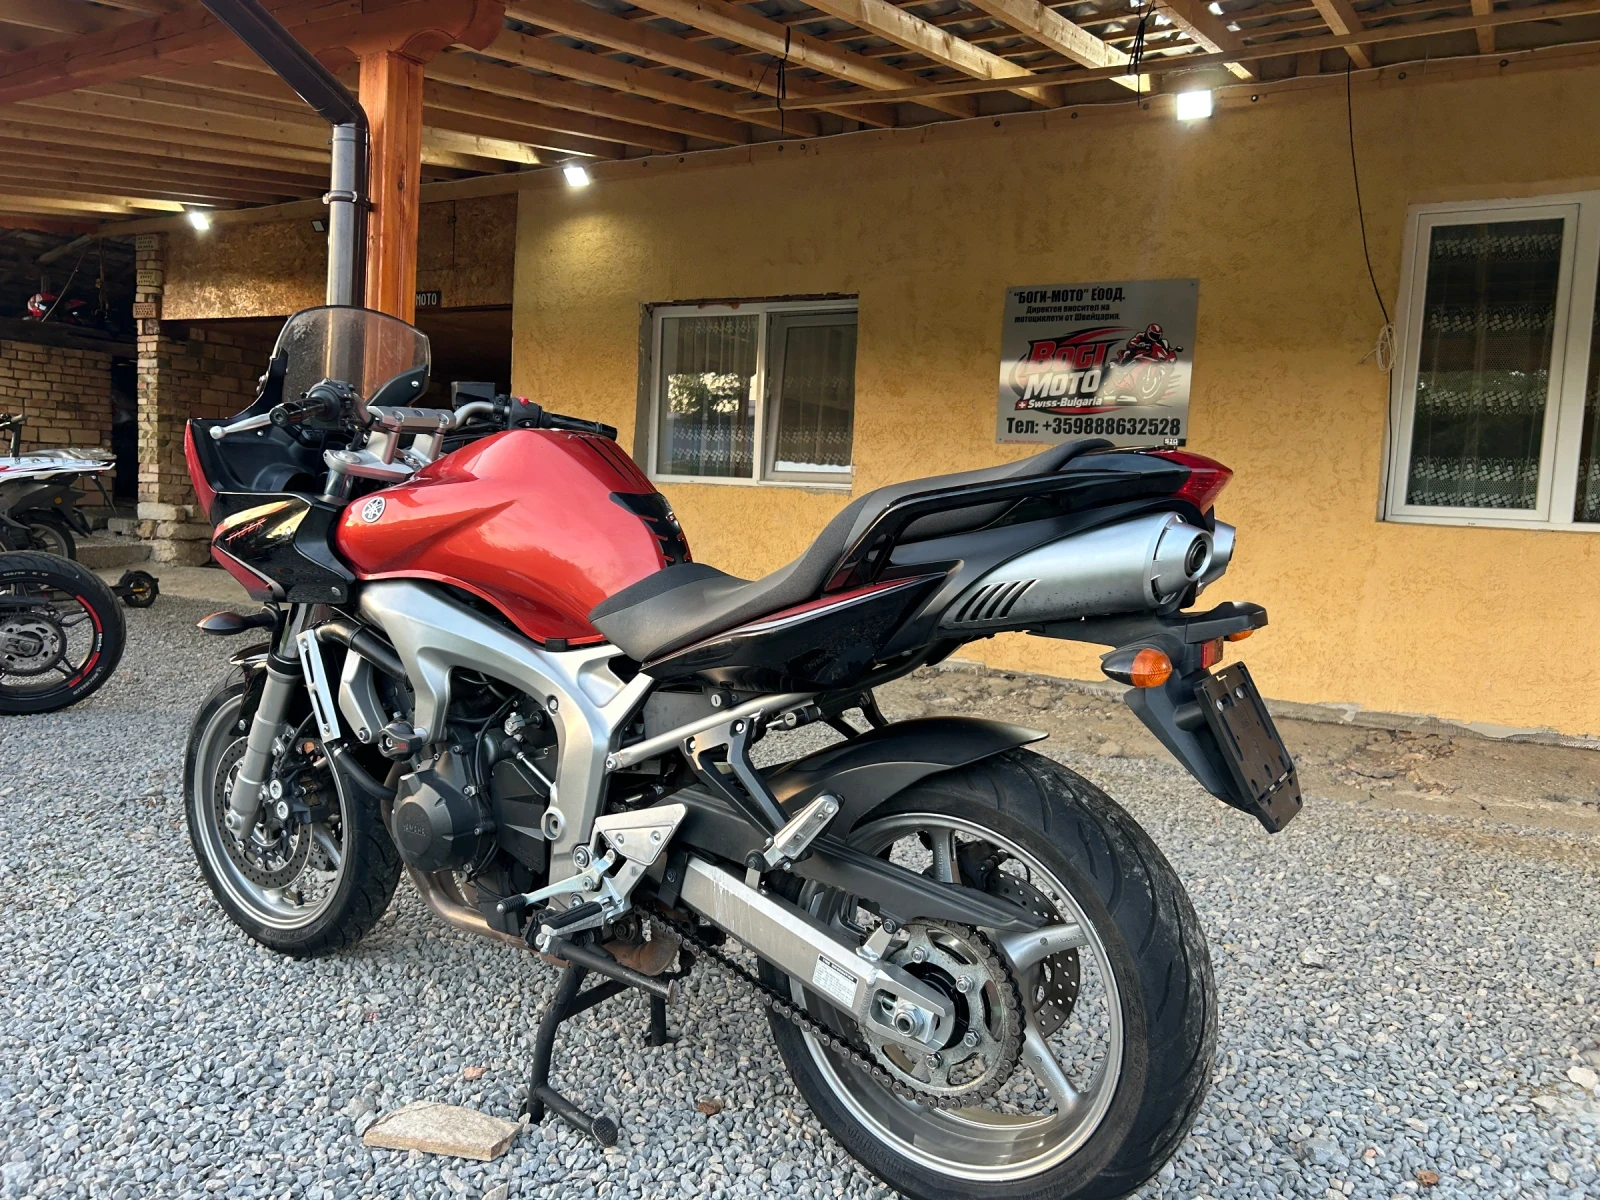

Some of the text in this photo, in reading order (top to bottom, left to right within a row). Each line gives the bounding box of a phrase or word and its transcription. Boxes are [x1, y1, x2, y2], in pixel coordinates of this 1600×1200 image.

[415, 292, 437, 306] MOTO
[1091, 287, 1126, 302] ЕООД.
[1026, 303, 1110, 315] Директен вносител на
[1014, 312, 1121, 323] мотоциклети от Швейцария.
[1023, 369, 1102, 400] MOTO
[1027, 397, 1103, 409] Swiss-Bulgaria
[1006, 417, 1182, 436] Тел: +359888632528
